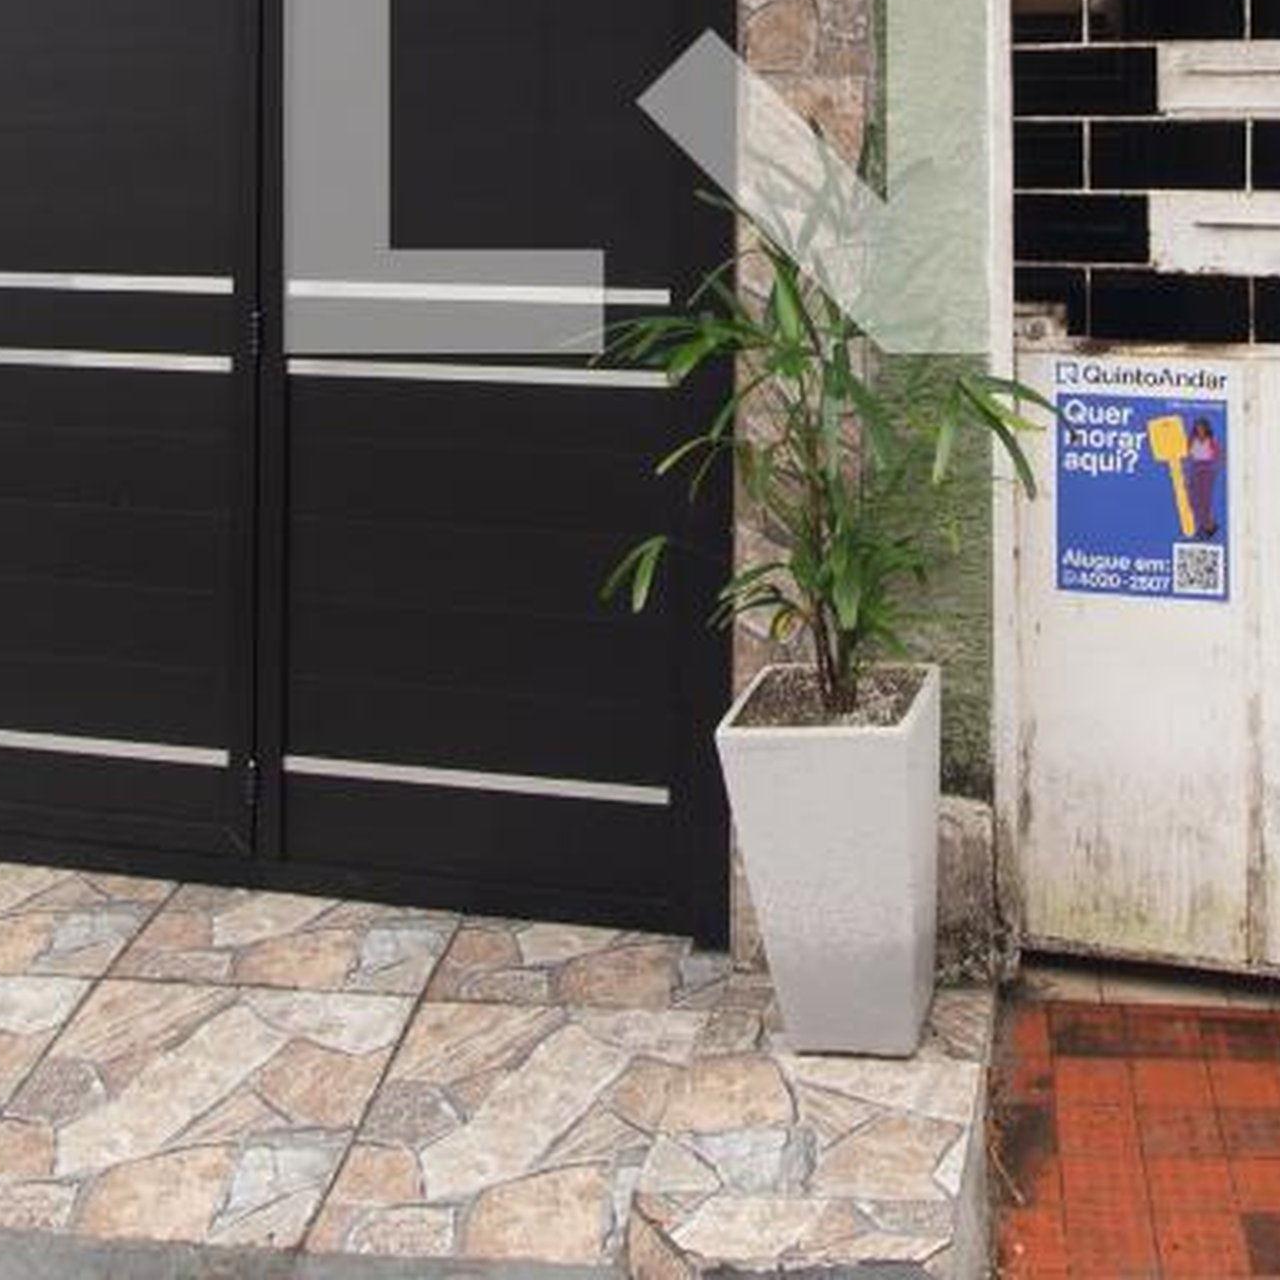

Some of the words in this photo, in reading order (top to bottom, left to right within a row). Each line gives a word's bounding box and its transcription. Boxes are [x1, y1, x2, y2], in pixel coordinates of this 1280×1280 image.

[1083, 363, 1227, 390] QuintoAndar
[1065, 398, 1133, 425] Quer
[1064, 448, 1139, 476] aqui?
[1062, 548, 1130, 572] Alugue
[1133, 557, 1171, 574] em:
